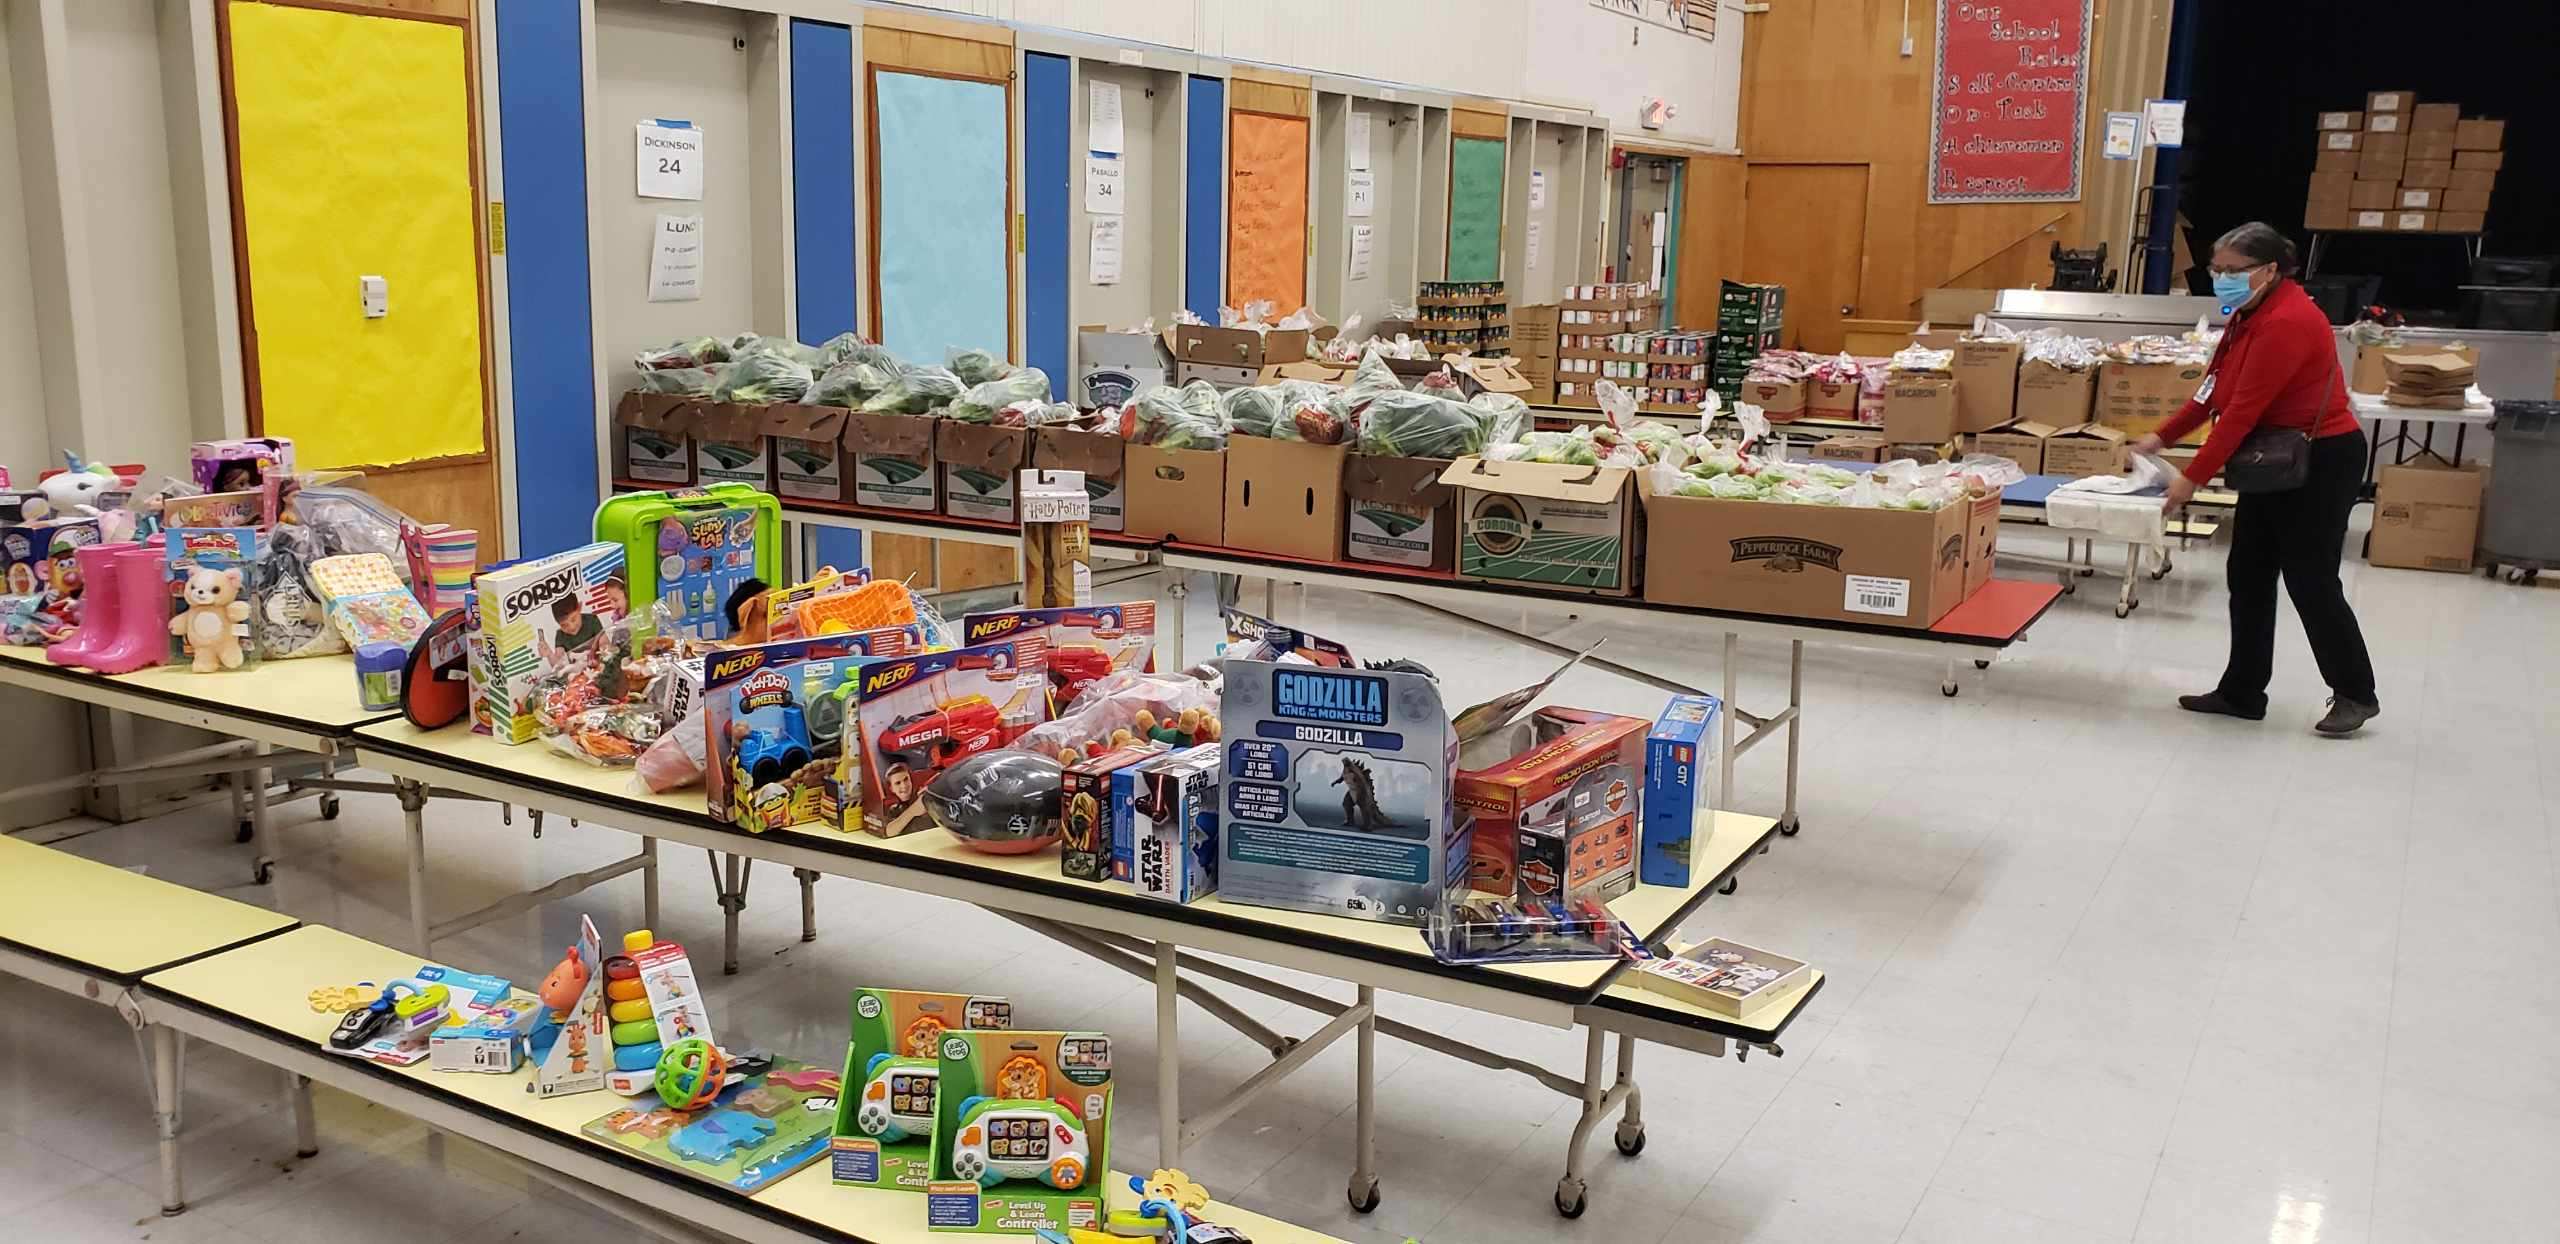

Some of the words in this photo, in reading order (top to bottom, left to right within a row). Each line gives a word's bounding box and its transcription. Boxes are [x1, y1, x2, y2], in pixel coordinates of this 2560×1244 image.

[1990, 19, 2060, 41] School
[644, 136, 696, 151] DICKINSON
[658, 158, 681, 174] 24
[1098, 184, 1113, 196] 34
[1894, 387, 1938, 399] MACARONI
[1823, 447, 1865, 459] MACARONI
[1029, 502, 1057, 518] Harry
[1057, 499, 1086, 516] Potter
[1477, 519, 1522, 533] CORONA
[702, 535, 724, 550] LAB
[1740, 542, 1800, 555] PEPPERIDGE
[1802, 543, 1833, 560] FARM
[505, 564, 581, 621] SORRY!
[971, 616, 1020, 639] NERF
[485, 634, 504, 687] SORRY!
[712, 651, 765, 680] NERF
[866, 663, 916, 693] NERF
[750, 693, 784, 708] WHEELS
[1279, 673, 1382, 713] GODZILLA
[1279, 703, 1307, 718] KING
[1319, 708, 1382, 724] MONSTERS
[898, 728, 943, 747] MEGA
[1295, 726, 1364, 746] GODZILLA
[1187, 770, 1209, 784] STAR
[1554, 766, 1581, 785] RADIO
[1677, 764, 1689, 787] CITY
[1185, 779, 1209, 796] WARS
[1457, 797, 1507, 812] ONTROL
[1164, 840, 1172, 865] VADER
[1141, 834, 1152, 892] STAR
[1151, 836, 1163, 892] WARS
[1008, 1201, 1032, 1210] Level
[1034, 1202, 1047, 1212] Up
[1019, 1210, 1045, 1218] Learn
[996, 1217, 1059, 1230] Controller
